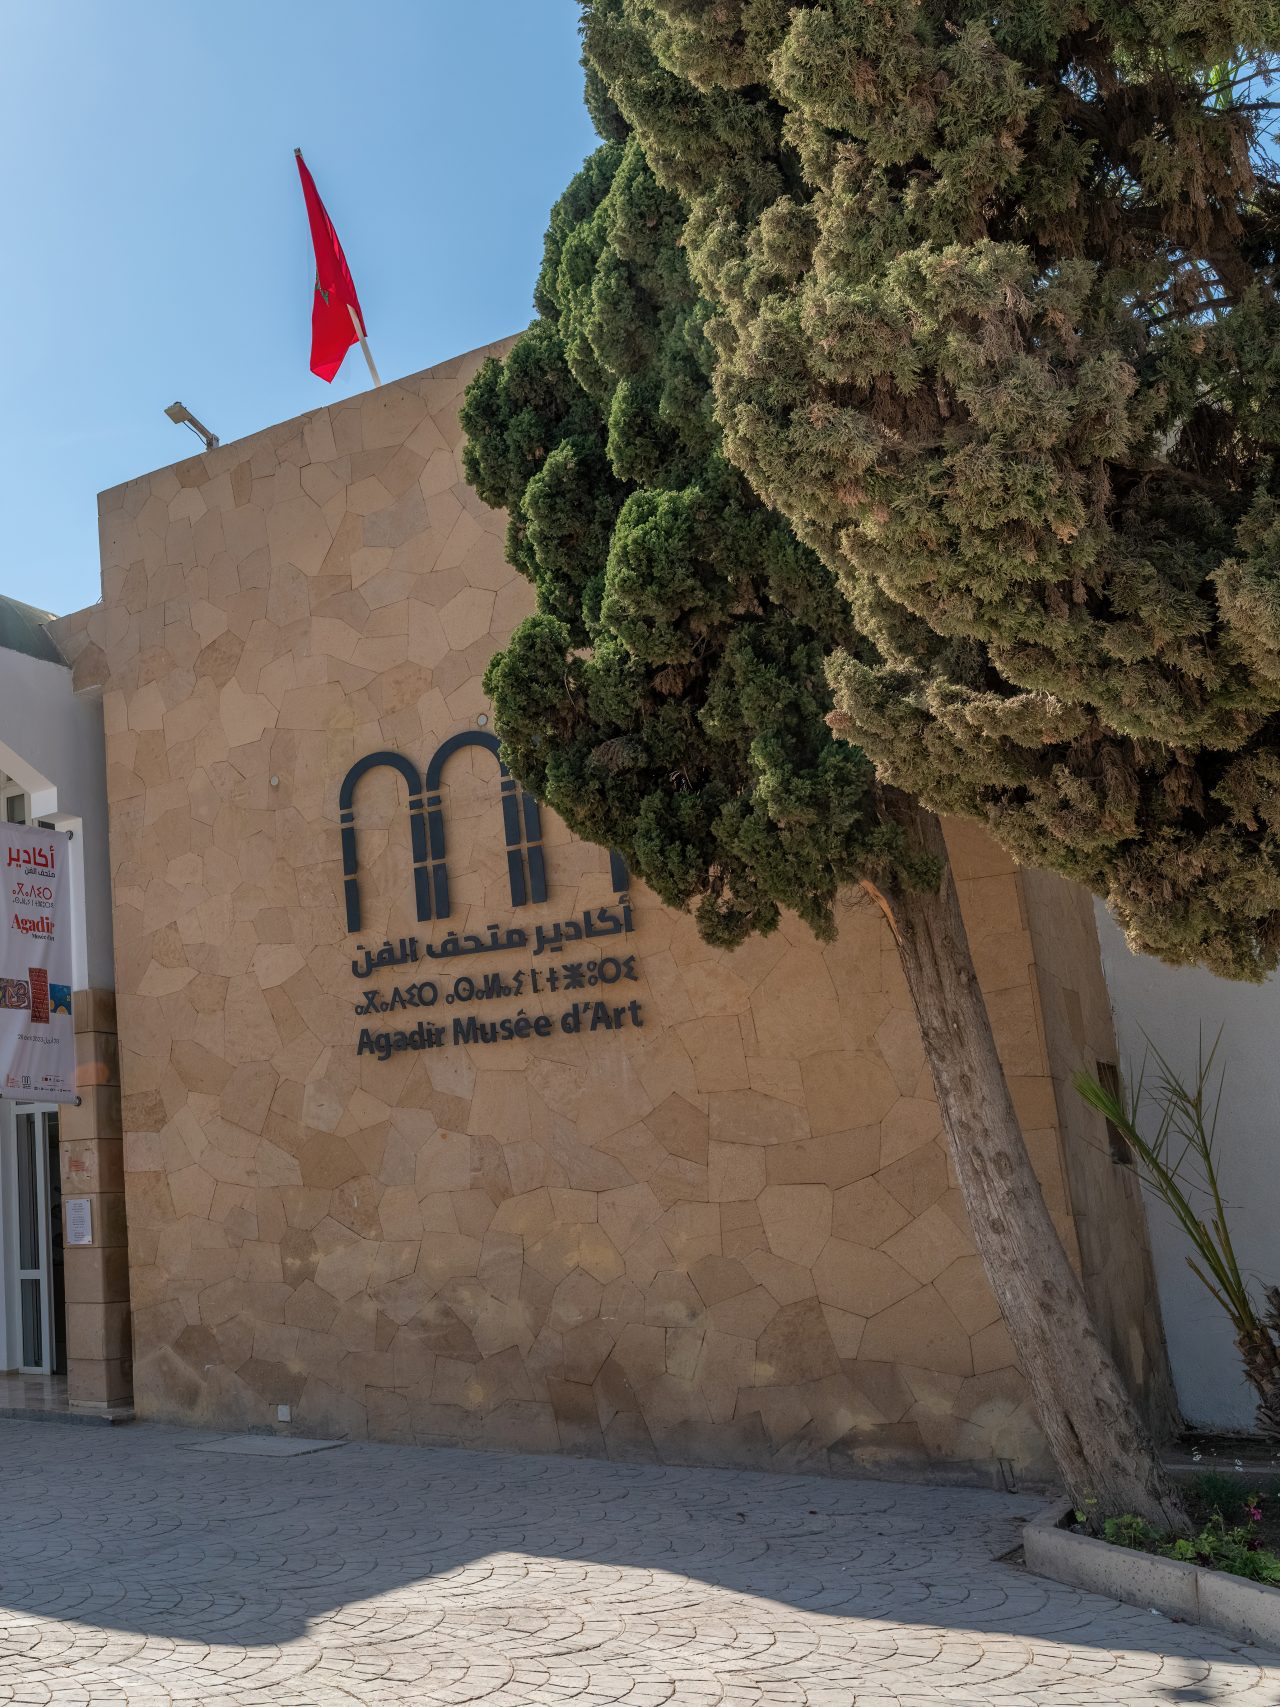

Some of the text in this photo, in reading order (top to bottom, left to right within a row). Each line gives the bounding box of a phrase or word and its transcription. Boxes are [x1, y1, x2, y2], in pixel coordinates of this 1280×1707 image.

[7, 845, 55, 869] أكادير
[11, 913, 55, 934] Agadir
[351, 893, 634, 979] أكادير متحف الفن
[356, 999, 644, 1061] Agadir Musée d'Art
